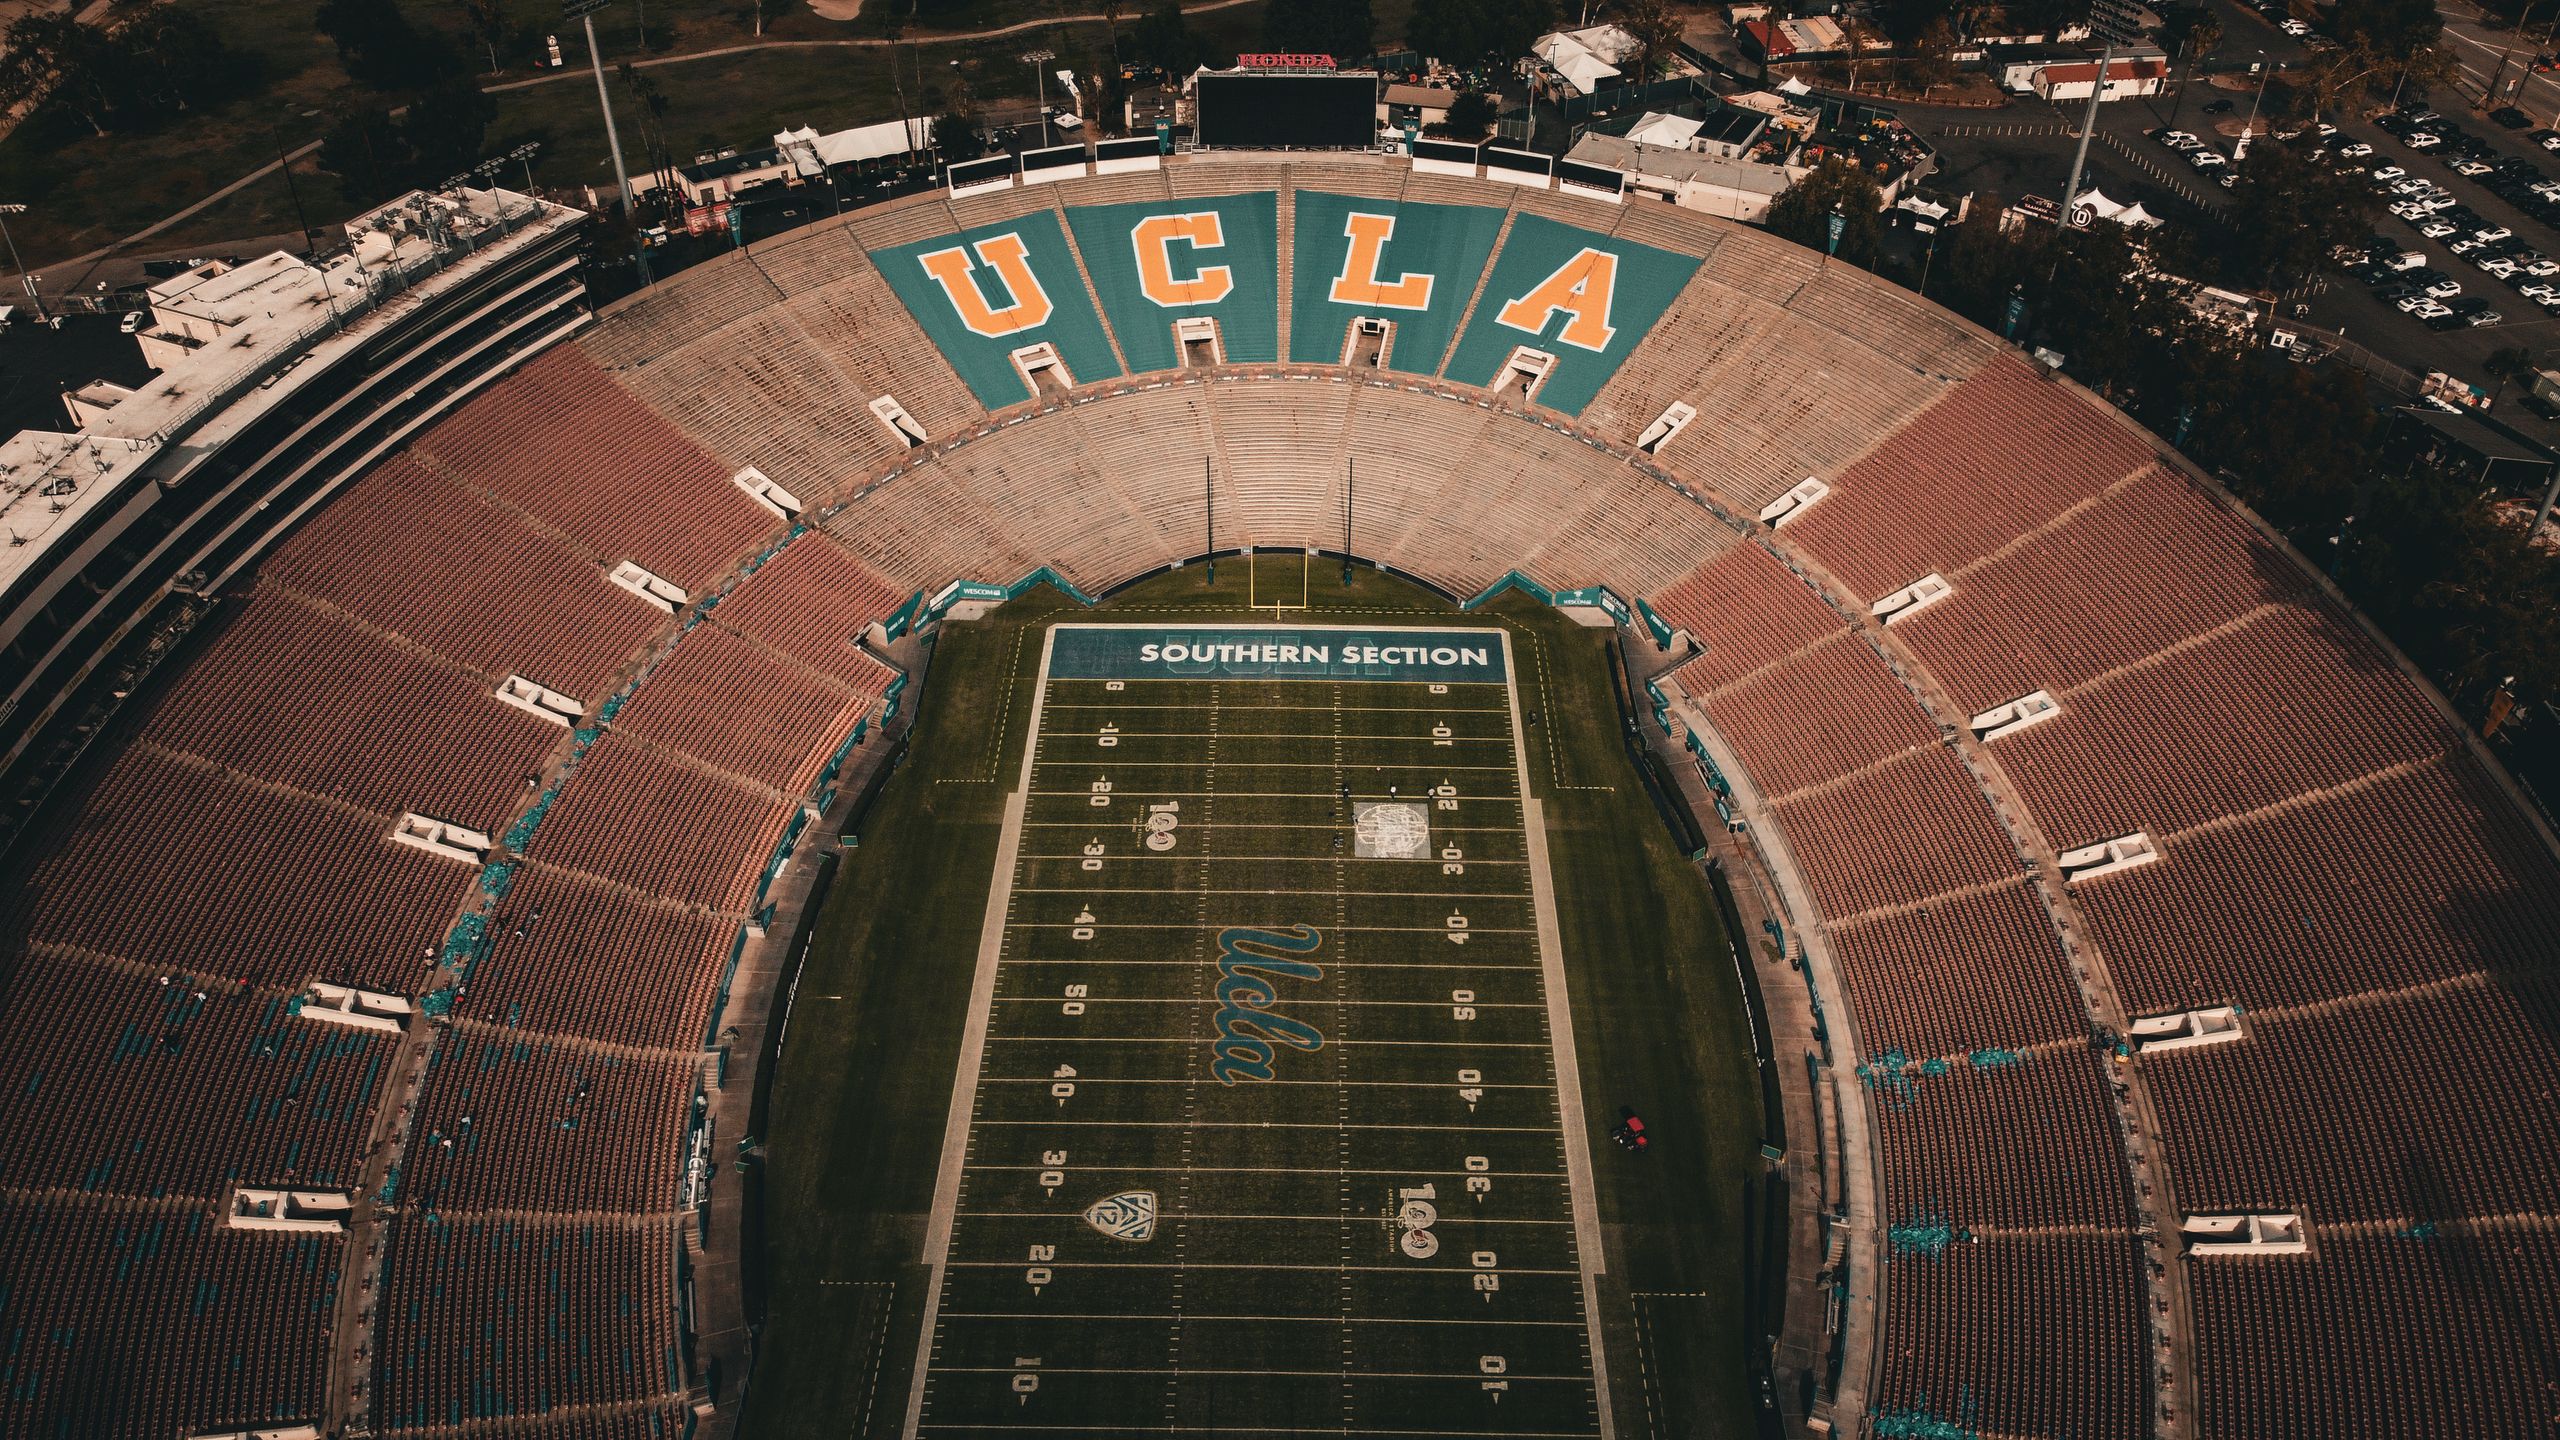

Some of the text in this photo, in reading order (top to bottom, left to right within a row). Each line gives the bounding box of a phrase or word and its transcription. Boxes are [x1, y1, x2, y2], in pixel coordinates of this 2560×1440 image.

[1238, 53, 1338, 67] HONDA
[917, 211, 1620, 353] UCLA
[963, 588, 994, 596] WESCOM
[1140, 644, 1488, 666] SOUTHERN SECTION
[1105, 681, 1125, 691] G
[1429, 684, 1448, 694] G
[1098, 727, 1119, 747] 10
[1432, 727, 1453, 746] 10
[1090, 781, 1112, 807] 20
[1436, 785, 1459, 811] 20
[1081, 844, 1105, 871] 30
[1441, 848, 1464, 875] 30
[1072, 911, 1096, 941] 40
[1446, 916, 1470, 945] 40
[1062, 984, 1088, 1016] 50
[1452, 989, 1476, 1021] 50
[1051, 1063, 1077, 1098] 40
[1457, 1068, 1483, 1103] 40
[1040, 1150, 1068, 1187] 30
[1464, 1155, 1492, 1192] 30
[1025, 1244, 1056, 1285] 20
[1471, 1250, 1500, 1291] 20
[1011, 1357, 1042, 1393] 10
[1479, 1355, 1509, 1391] 10
